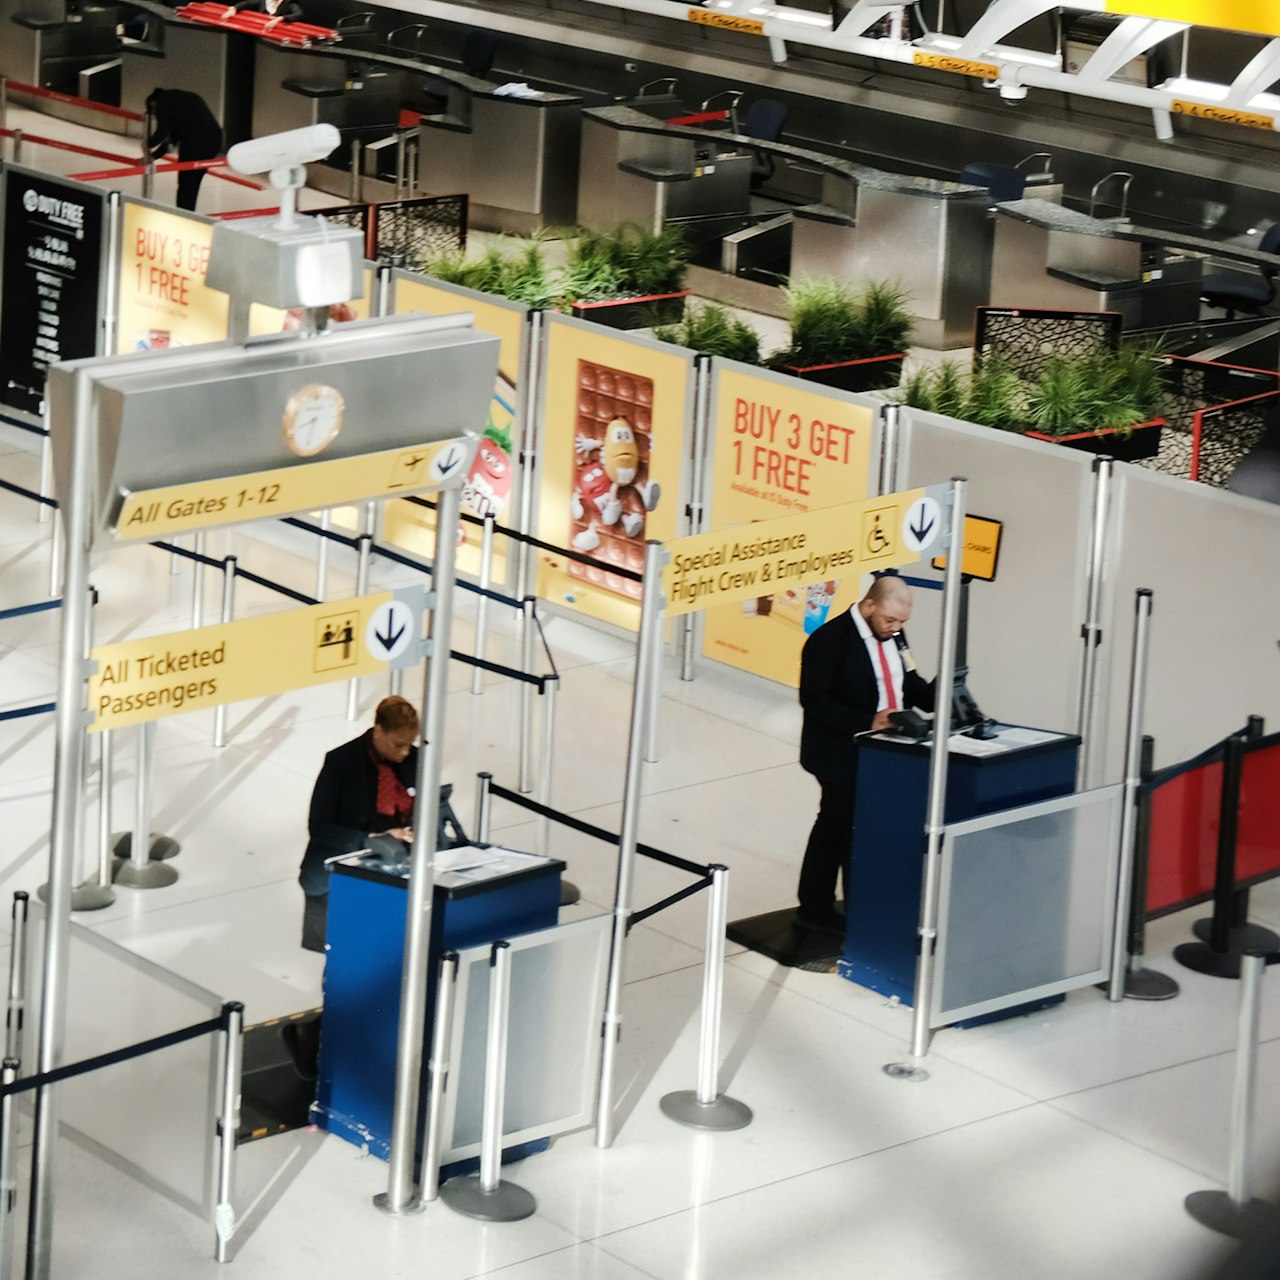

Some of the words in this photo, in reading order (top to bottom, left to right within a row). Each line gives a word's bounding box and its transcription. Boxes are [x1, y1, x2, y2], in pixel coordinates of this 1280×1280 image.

[940, 58, 985, 74] Check-in
[1203, 108, 1256, 125] Check-in
[38, 194, 62, 216] DUTY
[61, 199, 84, 224] FREE
[136, 225, 168, 264] BUY
[173, 238, 183, 269] 3
[136, 262, 143, 292] 1
[150, 266, 189, 307] FREE
[734, 397, 781, 443] BUY
[787, 413, 801, 450] 3
[810, 419, 855, 465] GET
[733, 440, 742, 476] 1
[128, 502, 161, 527] All
[166, 495, 228, 520] Gates
[236, 484, 282, 509] 1-12
[673, 543, 727, 577] Special
[731, 531, 807, 563] Assistance
[671, 576, 715, 605] Flight
[718, 569, 755, 592] Crew
[761, 565, 772, 582] &
[777, 548, 854, 581] Employees
[99, 660, 129, 687] All
[136, 640, 226, 678] Ticketed
[98, 676, 218, 717] Passengers
